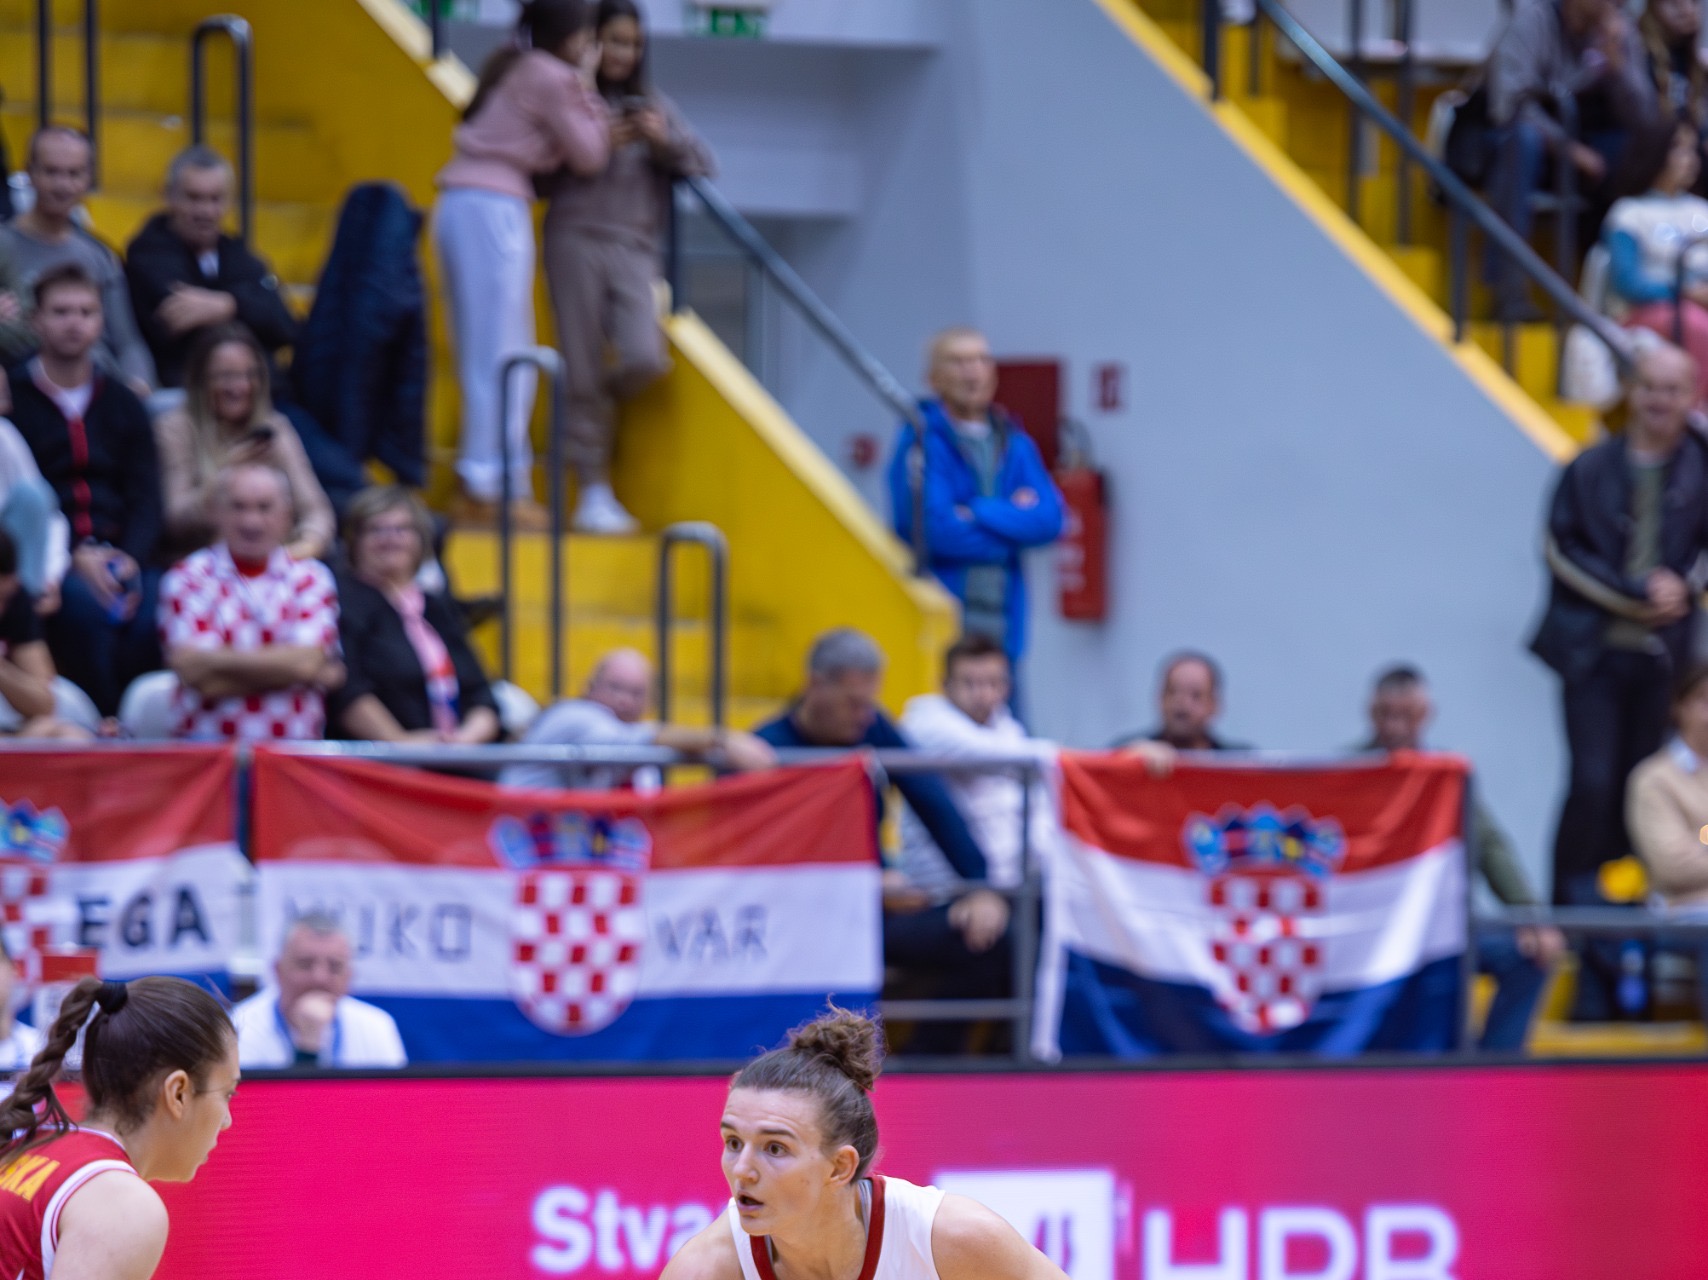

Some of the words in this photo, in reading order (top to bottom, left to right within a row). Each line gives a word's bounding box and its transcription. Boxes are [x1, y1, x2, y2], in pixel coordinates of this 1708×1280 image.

[78, 884, 212, 951] EGA
[653, 904, 768, 961] VAR
[532, 1184, 724, 1275] Stva
